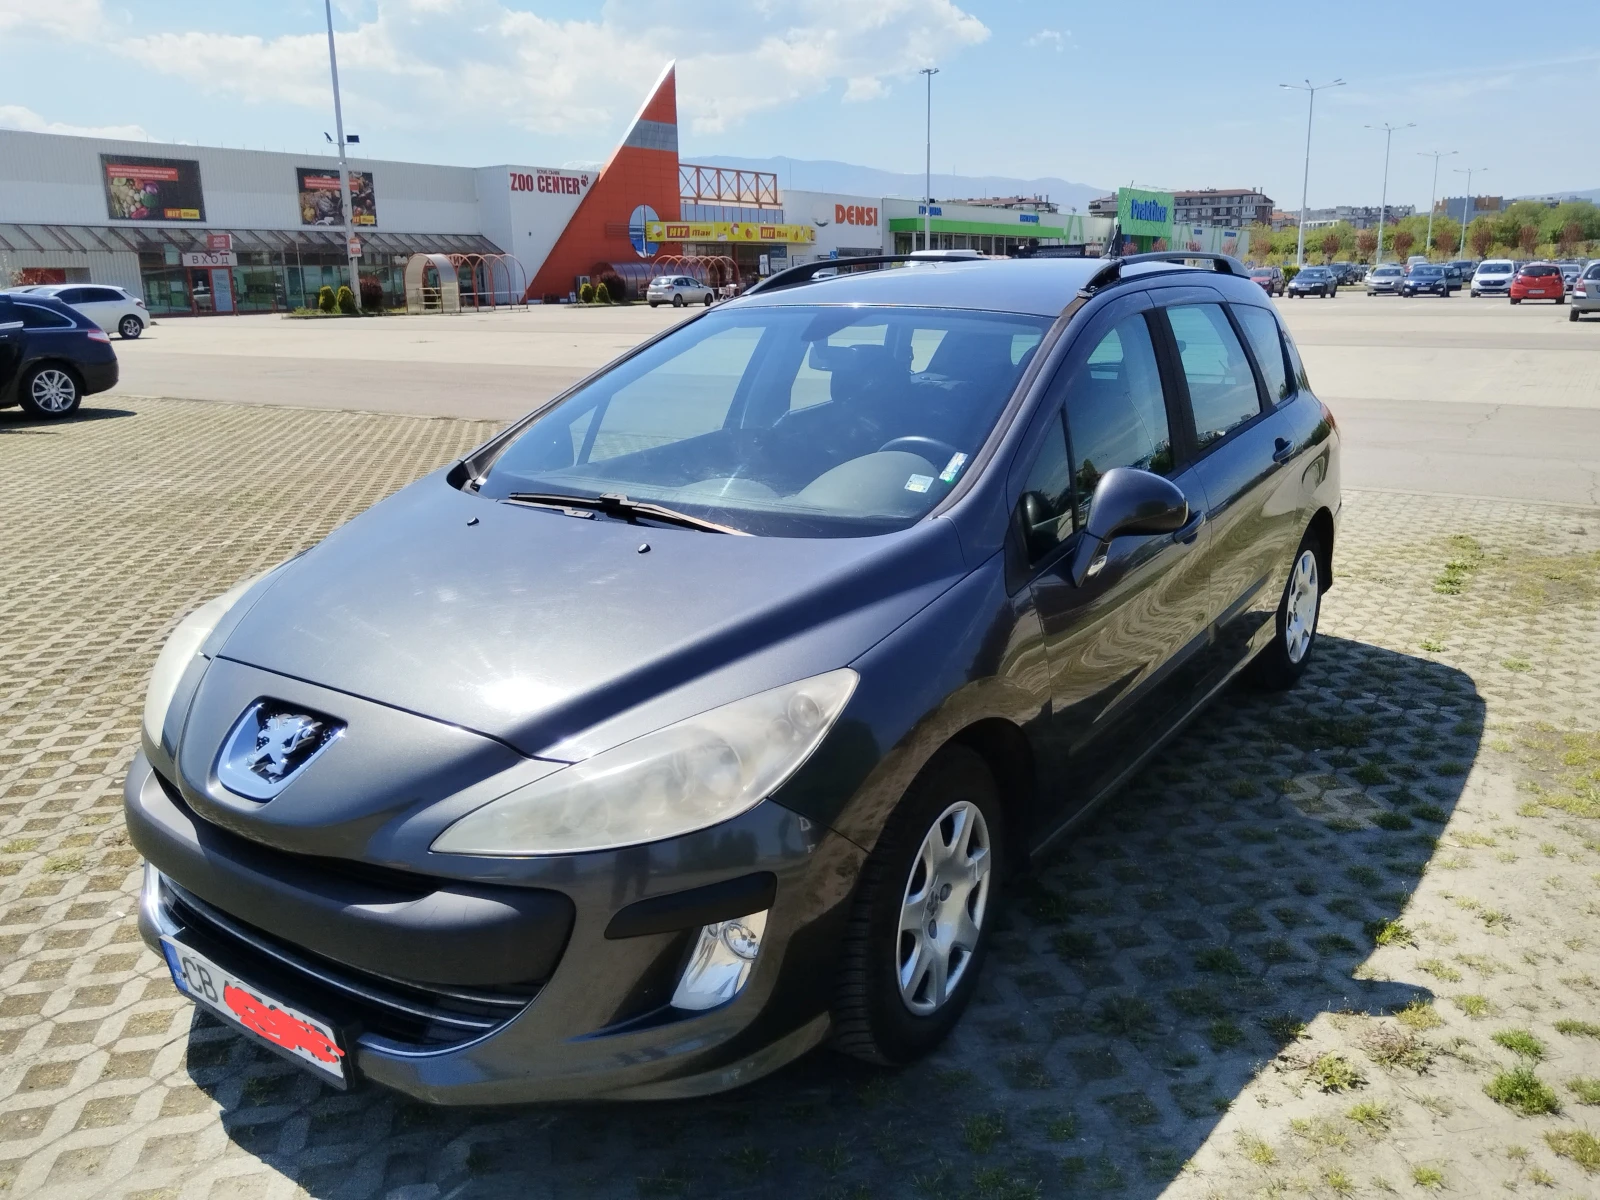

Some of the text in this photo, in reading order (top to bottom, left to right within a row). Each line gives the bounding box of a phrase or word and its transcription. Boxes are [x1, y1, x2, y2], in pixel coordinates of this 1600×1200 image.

[510, 173, 580, 195] ZOO CENTER
[835, 204, 878, 226] DENSI
[669, 227, 688, 237] HIT
[762, 227, 774, 238] HIT
[192, 255, 229, 265] ВХОД
